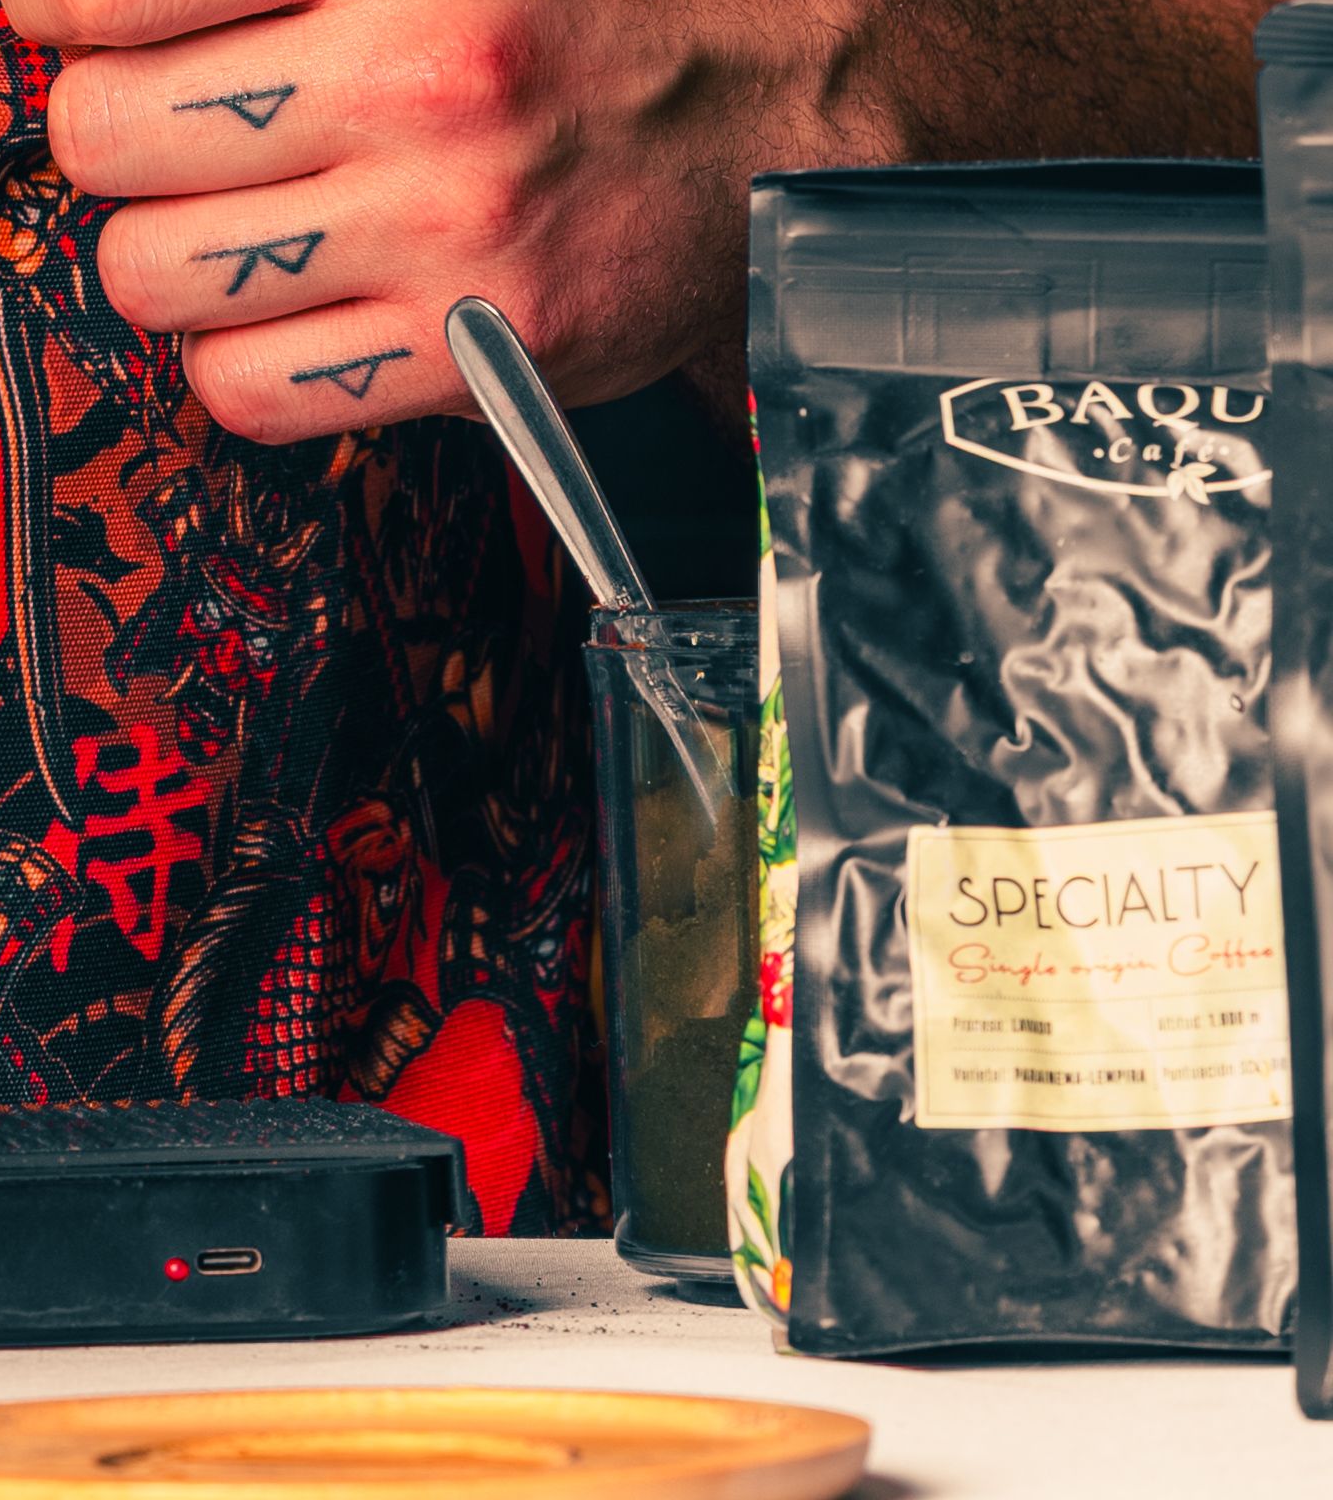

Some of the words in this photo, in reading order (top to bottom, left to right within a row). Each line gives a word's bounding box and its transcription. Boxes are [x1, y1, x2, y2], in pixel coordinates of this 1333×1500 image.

[1000, 379, 1264, 431] BAQU
[948, 860, 1261, 930] SPECIALTY
[947, 942, 1057, 986] Single
[1167, 932, 1275, 978] Coffee
